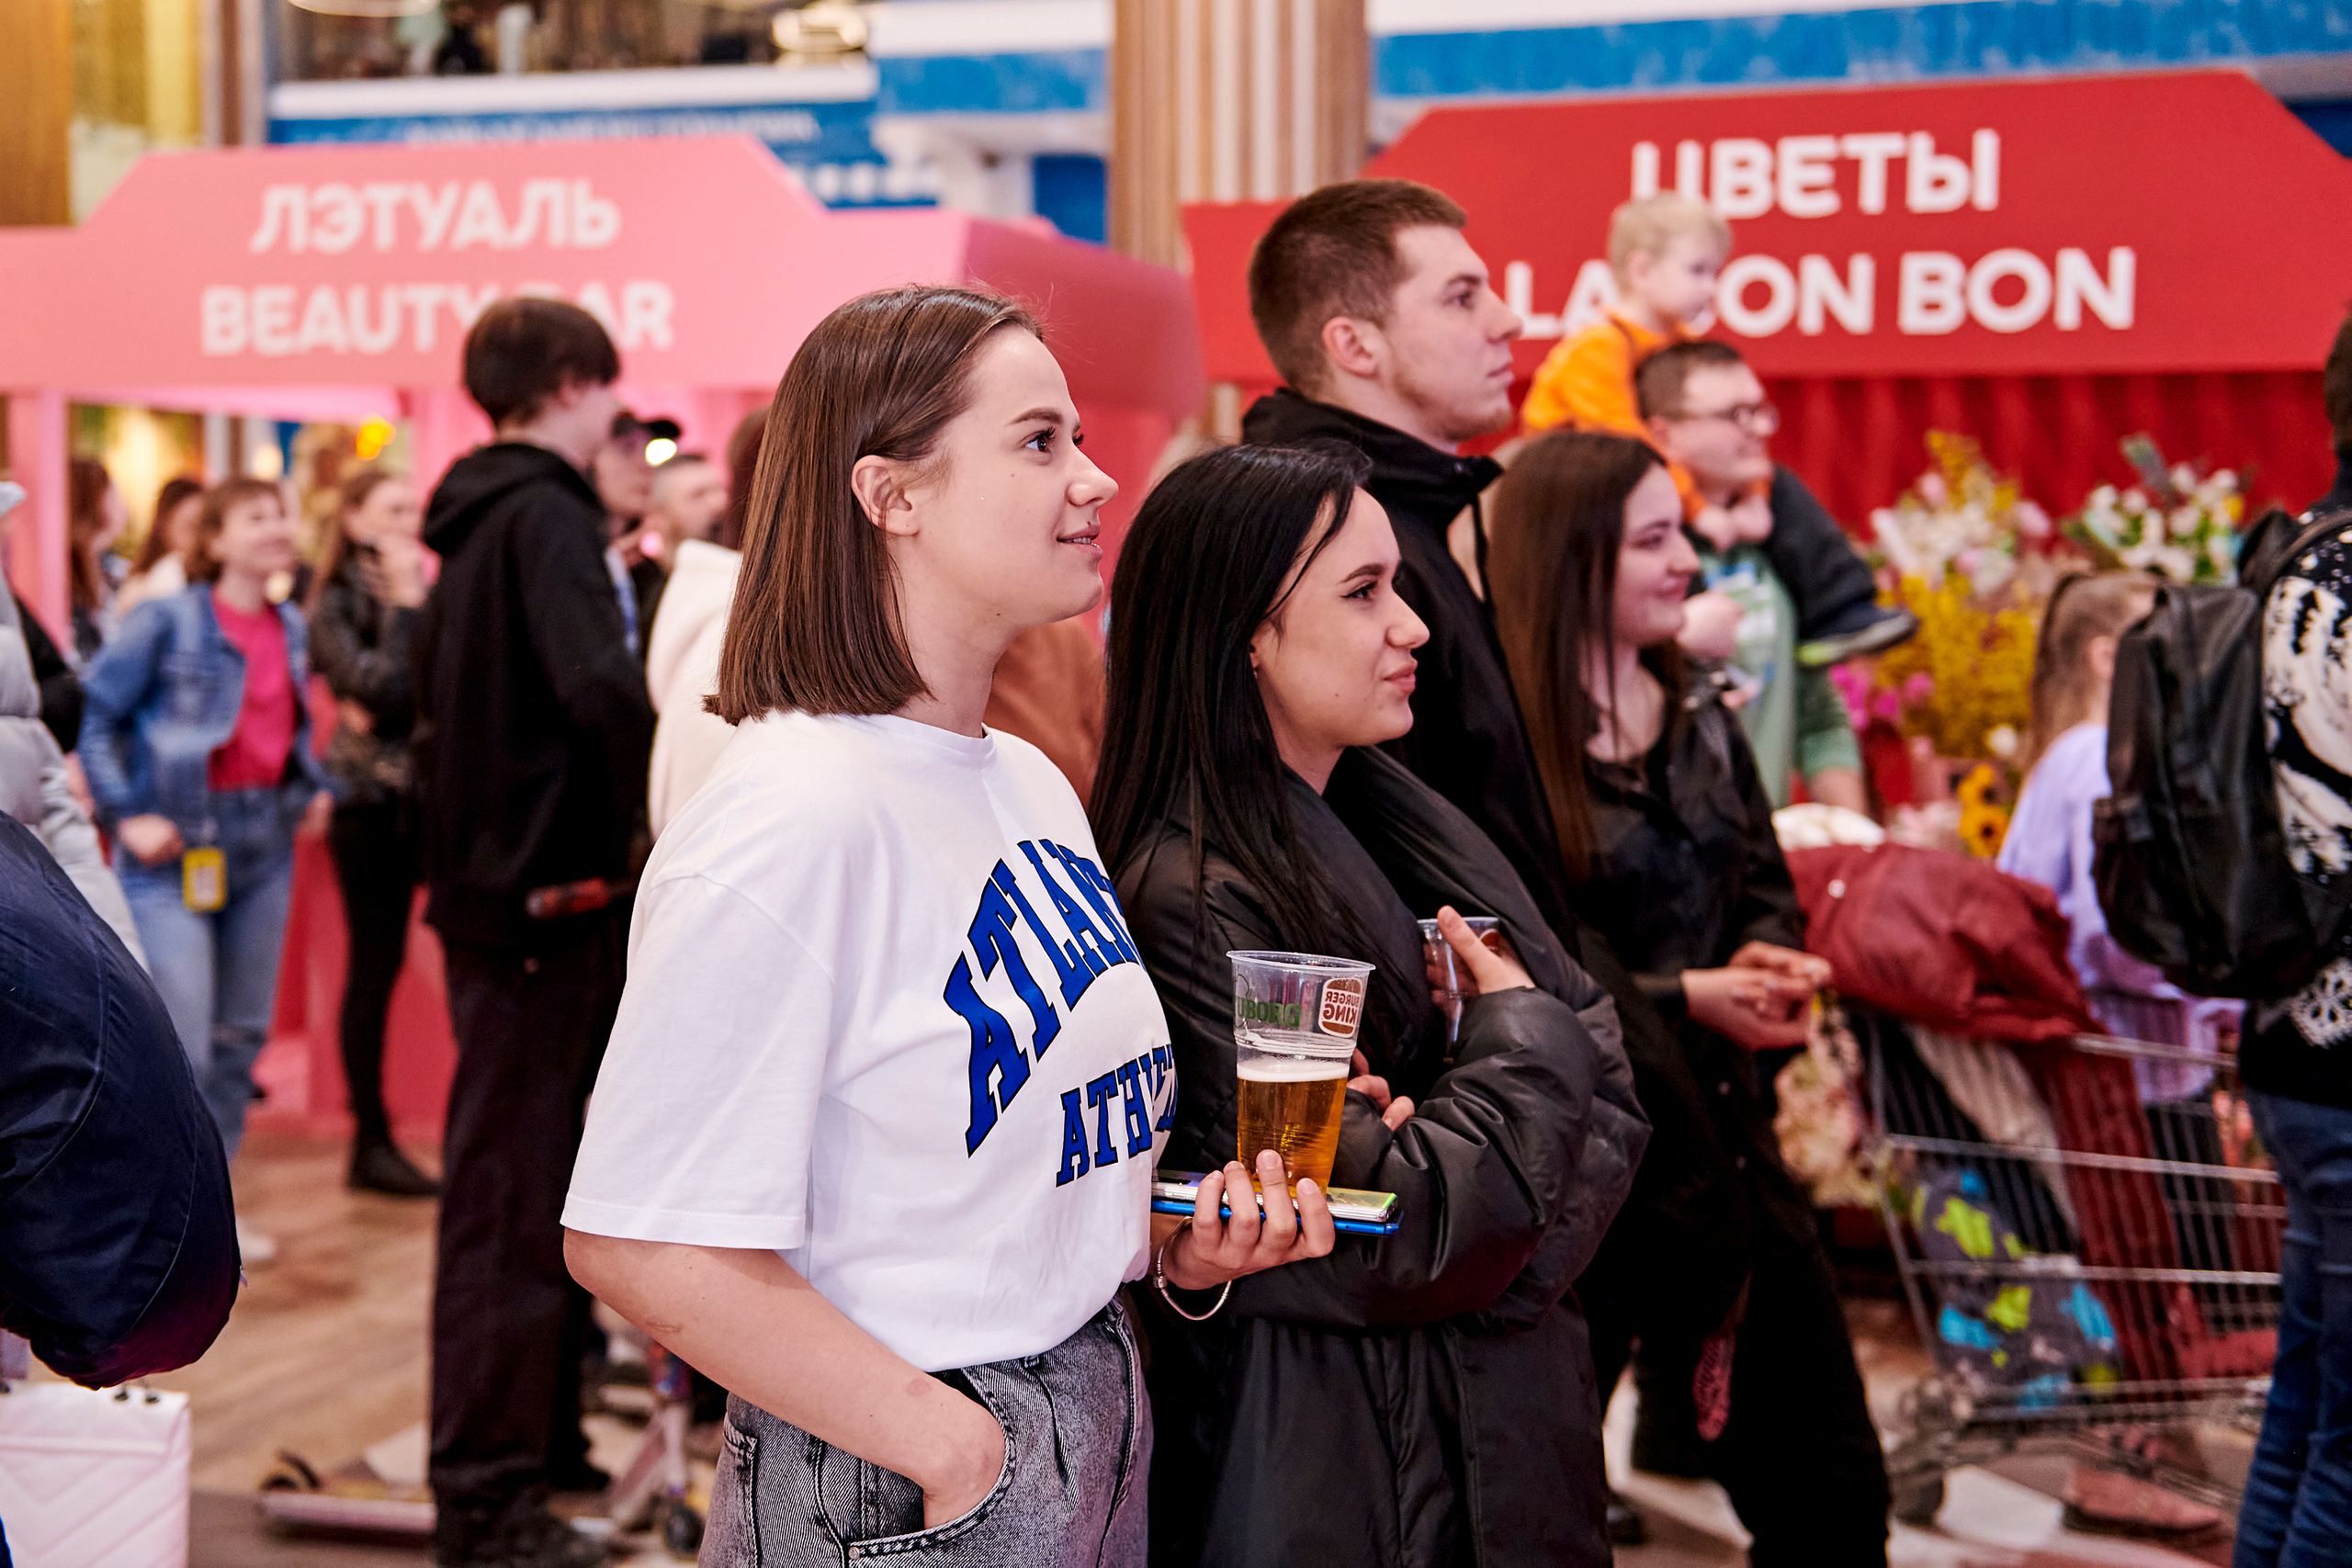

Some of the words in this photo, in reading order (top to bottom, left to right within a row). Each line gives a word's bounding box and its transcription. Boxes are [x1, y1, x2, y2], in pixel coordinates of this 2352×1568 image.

[249, 177, 622, 254] ЛЭТУАЛЬ
[1689, 253, 1875, 338] ON
[1897, 245, 2136, 336] BON
